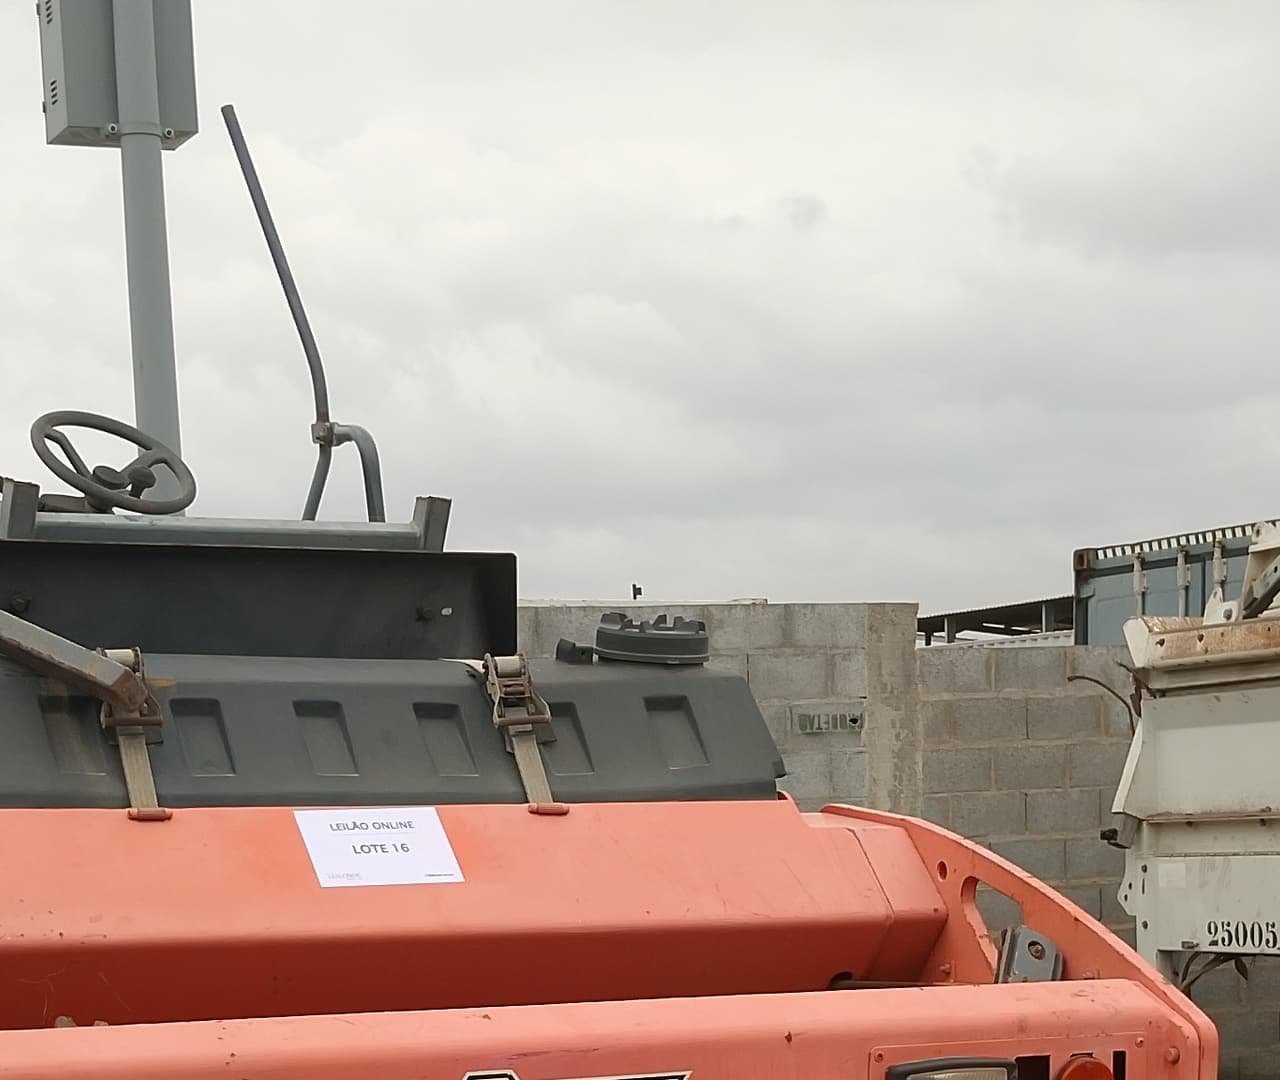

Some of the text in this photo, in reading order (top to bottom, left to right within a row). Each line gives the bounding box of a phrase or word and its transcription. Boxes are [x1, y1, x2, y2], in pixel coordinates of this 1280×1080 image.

[328, 820, 415, 832] LEILÃO ONLINE
[352, 843, 410, 854] LOTE 16
[1206, 920, 1278, 949] 25005
